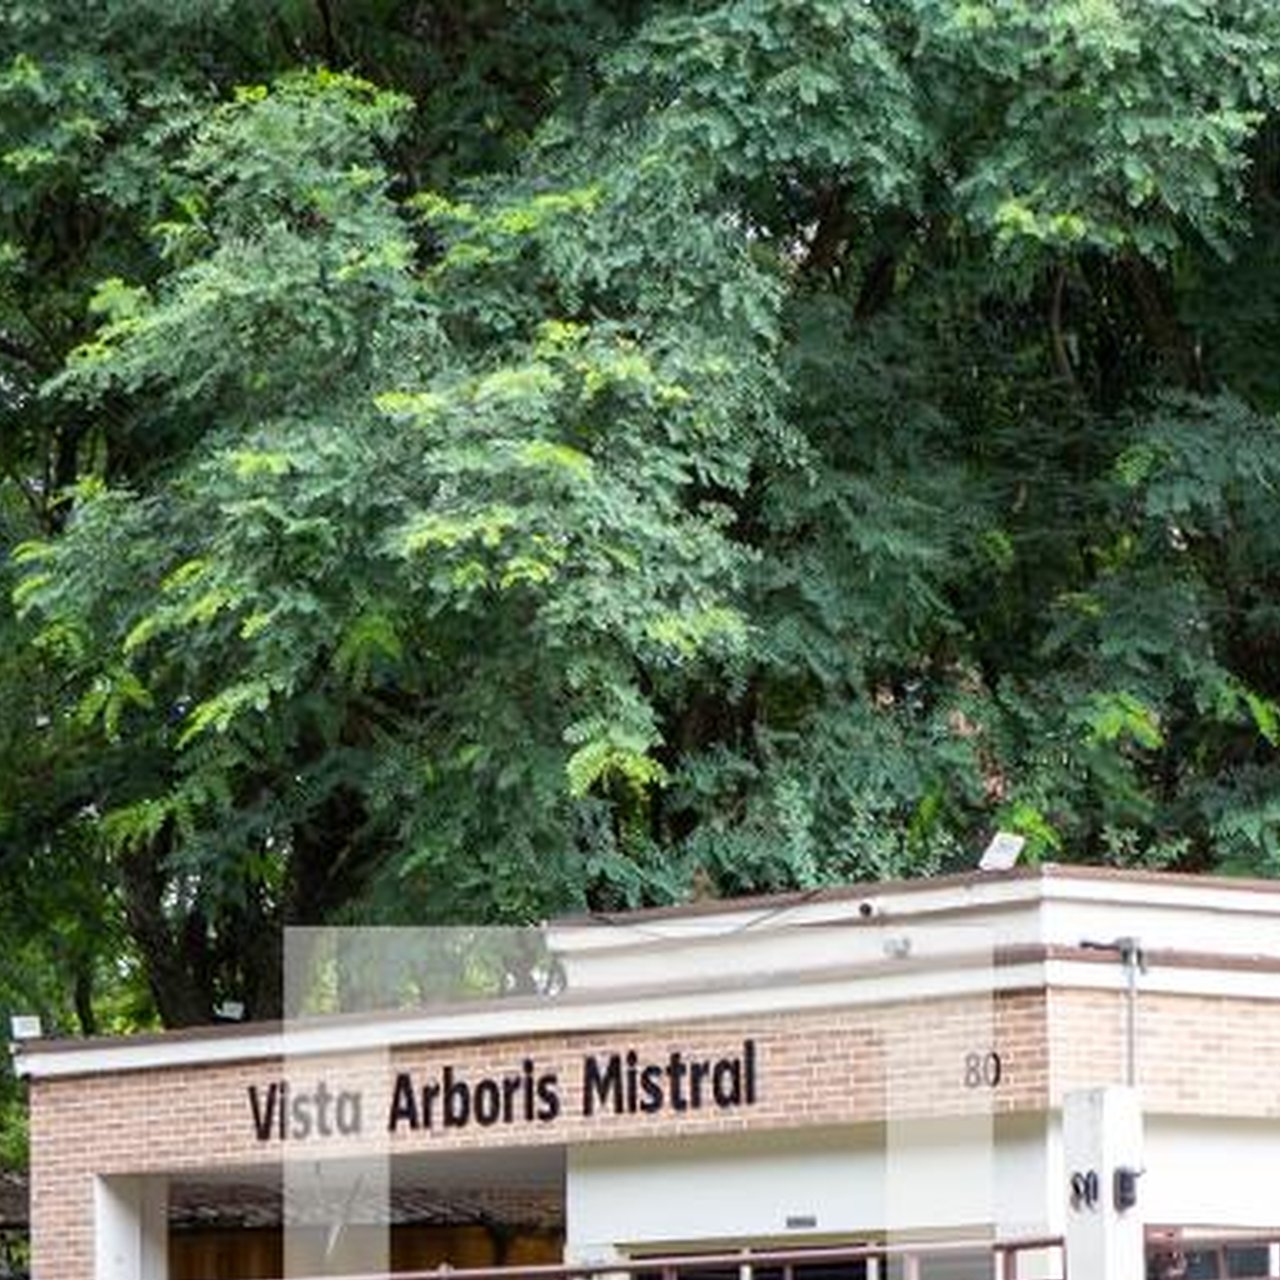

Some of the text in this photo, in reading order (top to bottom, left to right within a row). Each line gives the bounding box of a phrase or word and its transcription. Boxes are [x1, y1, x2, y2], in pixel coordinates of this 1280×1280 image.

[248, 1039, 755, 1141] Vista Arboris Mistral
[964, 1051, 1001, 1088] 80
